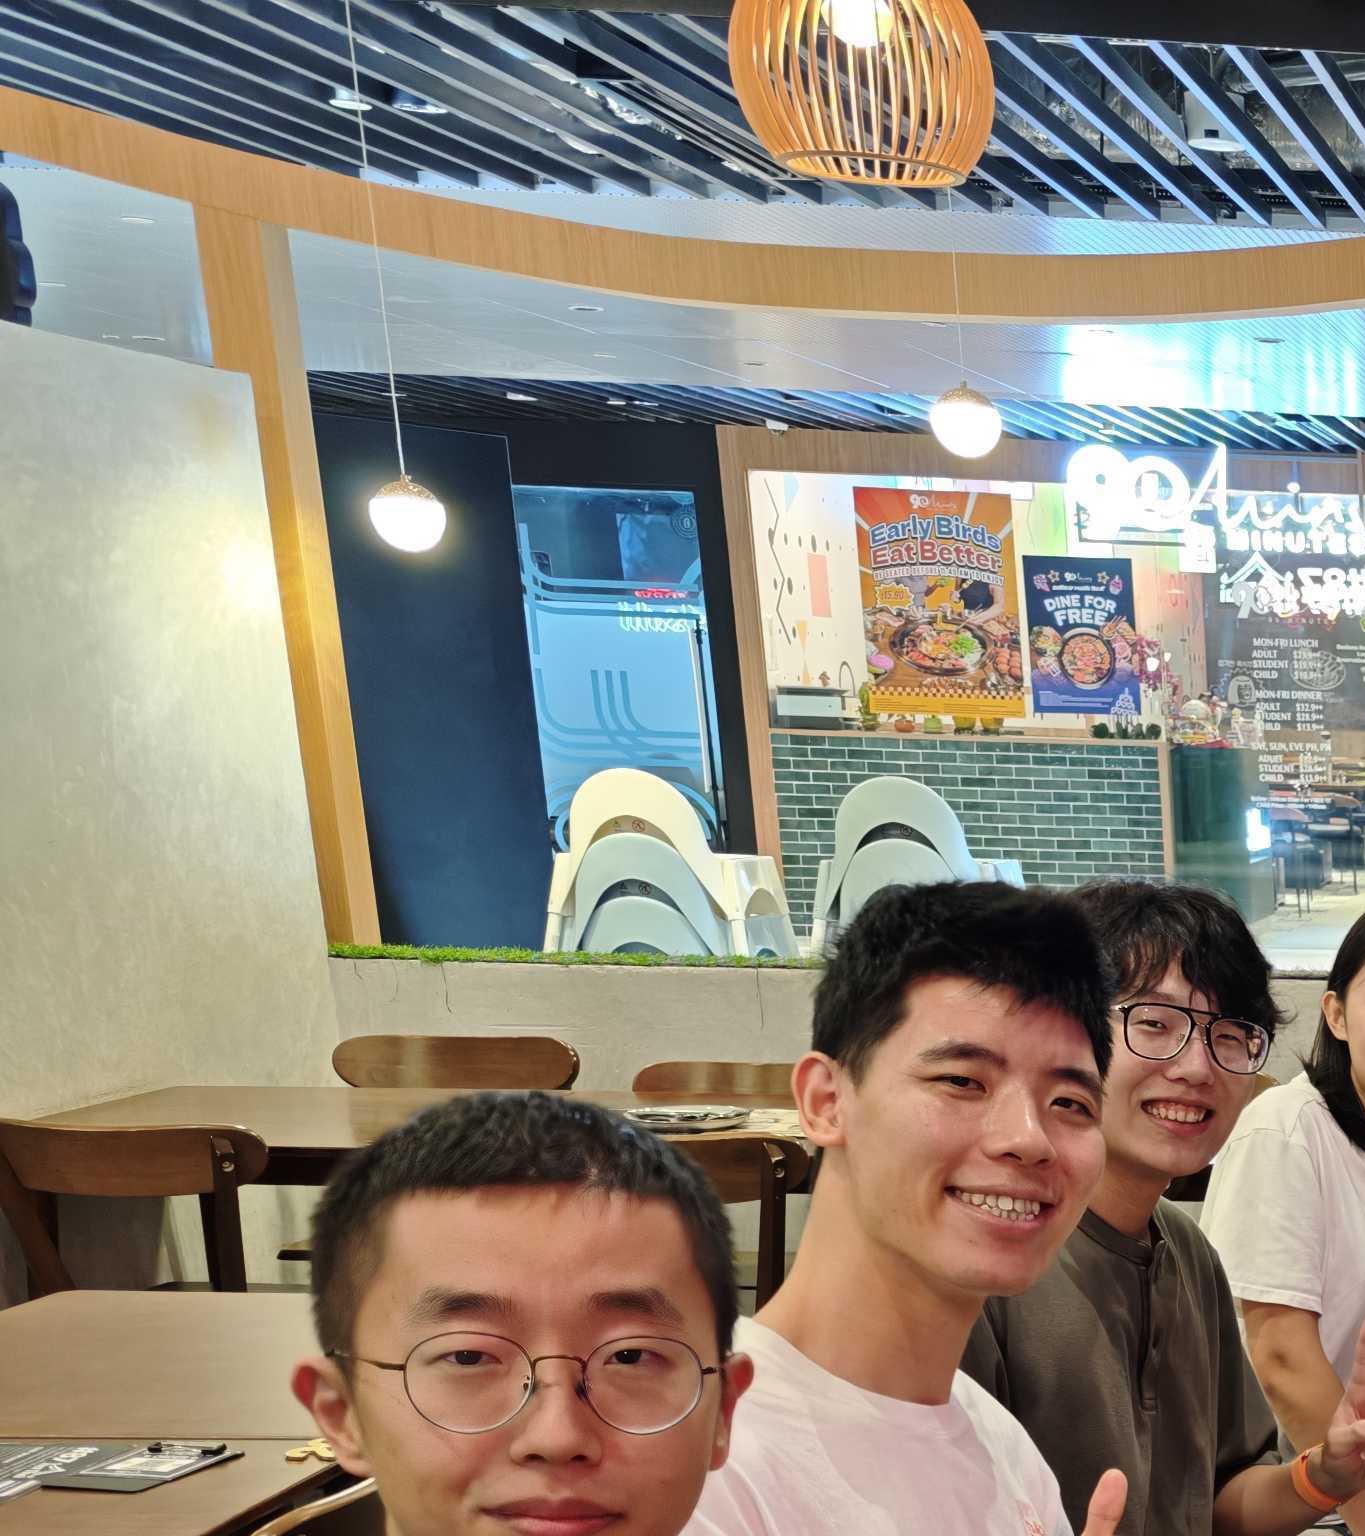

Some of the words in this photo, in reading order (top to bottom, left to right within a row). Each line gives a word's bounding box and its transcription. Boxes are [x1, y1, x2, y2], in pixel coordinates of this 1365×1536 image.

[869, 513, 932, 546] Early
[934, 514, 1002, 552] Birds
[871, 541, 918, 567] Eat
[918, 539, 1004, 573] Better
[883, 566, 911, 579] SEATED
[911, 565, 938, 576] BEFORE
[981, 571, 1005, 585] ENJOY
[1043, 594, 1081, 612] DINE
[1083, 594, 1118, 613] FOR
[1053, 608, 1108, 626] FREE
[1252, 637, 1289, 648] MON-FRI
[1289, 638, 1319, 648] LUNCH
[1252, 650, 1277, 659] ADULT
[1252, 660, 1288, 669] STUDENT
[1253, 670, 1278, 679] CHILD
[1255, 690, 1291, 699] MON-FRI
[1255, 702, 1281, 711] ADULT
[1259, 764, 1295, 773] STUDENT
[1259, 774, 1284, 782] CHILD
